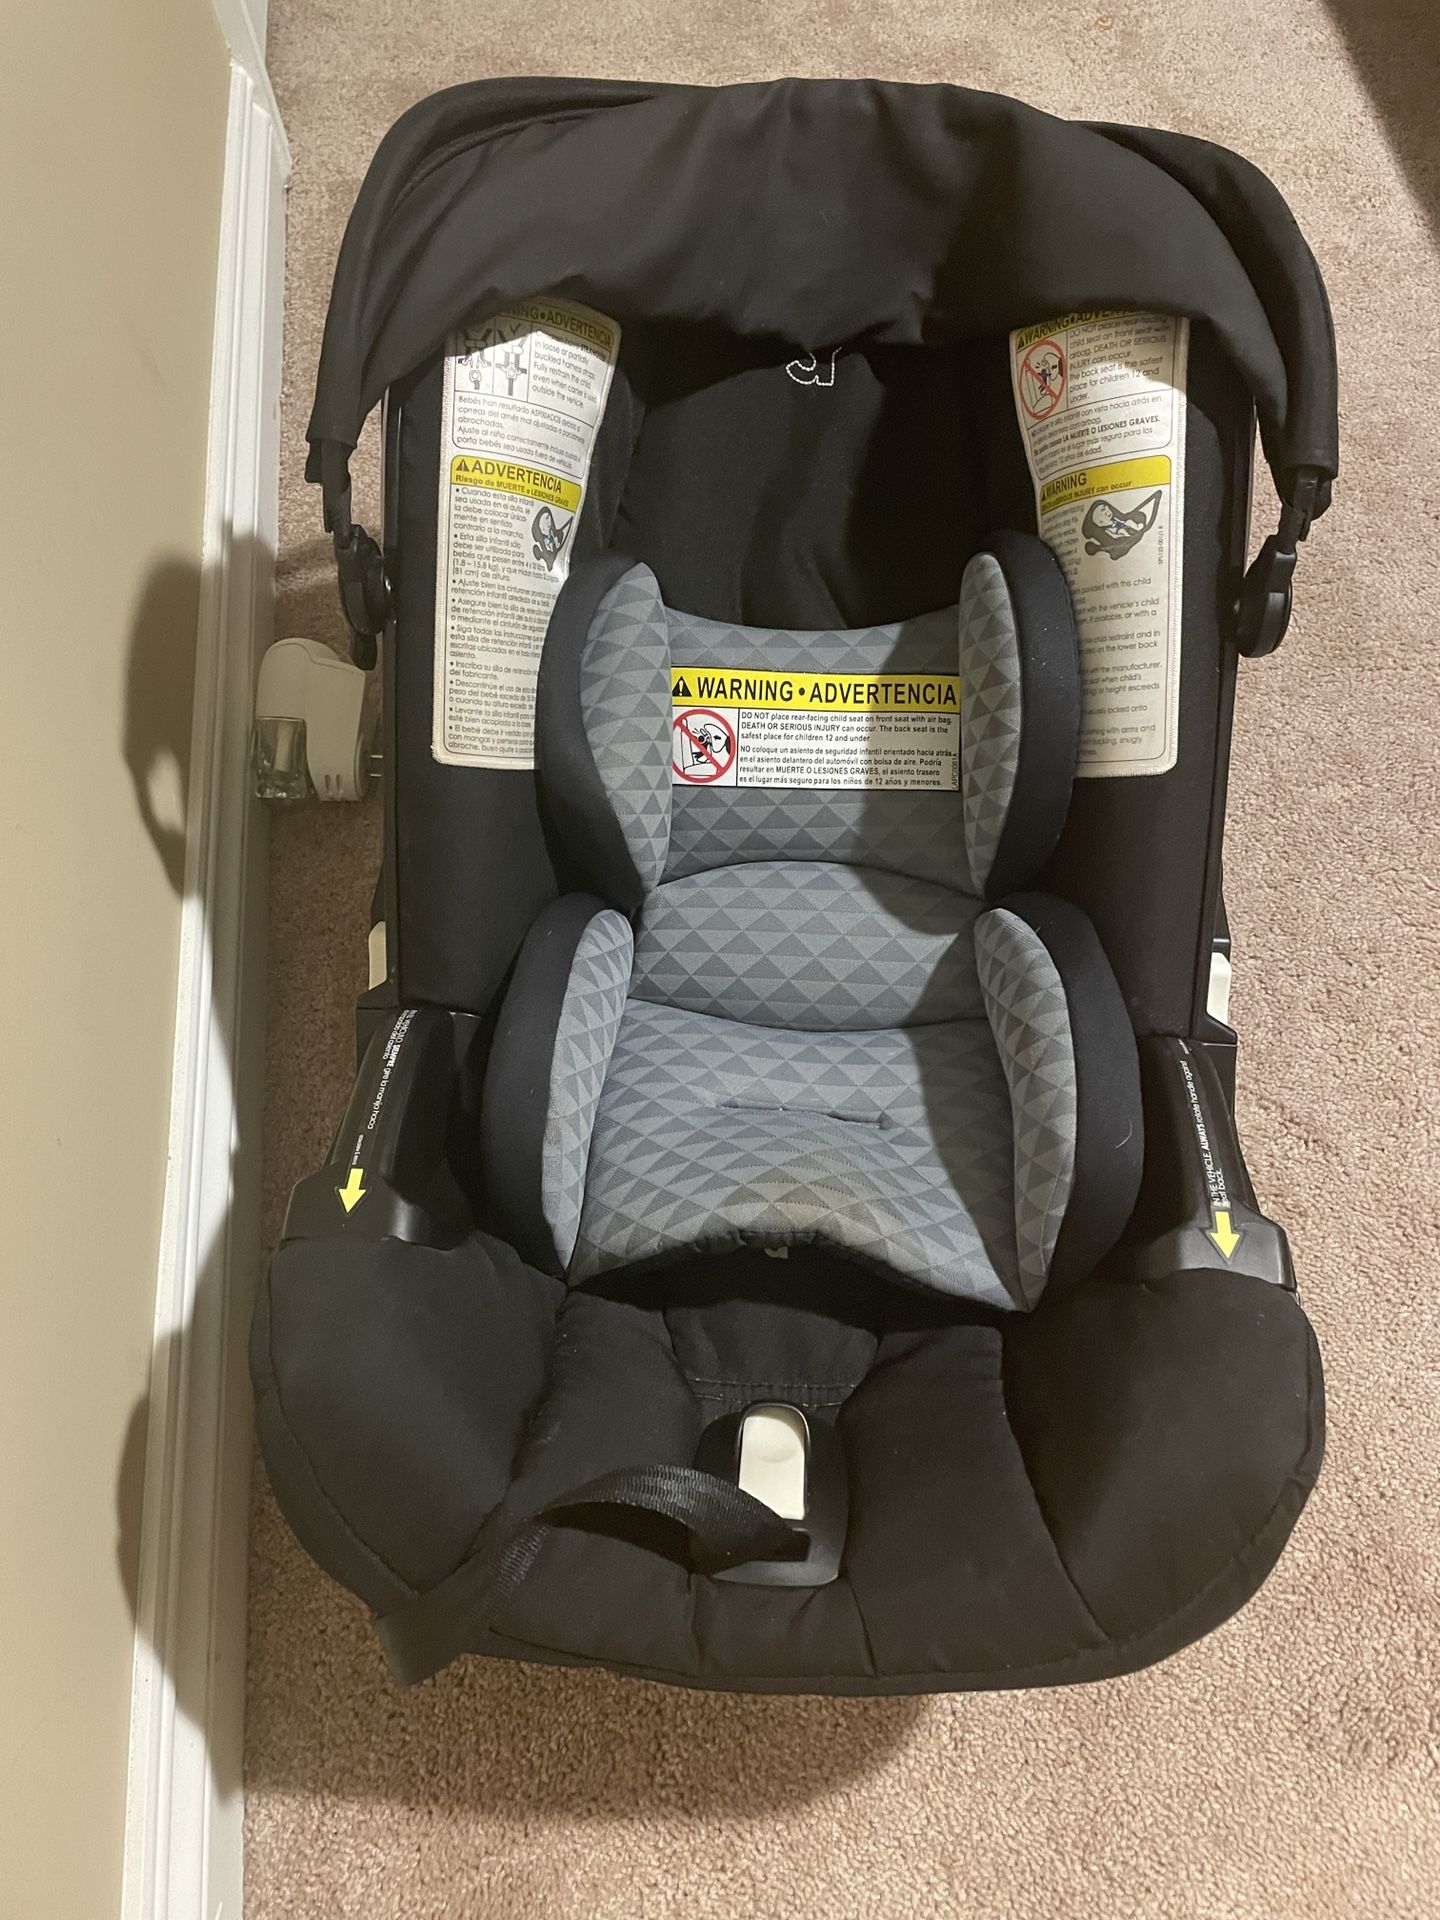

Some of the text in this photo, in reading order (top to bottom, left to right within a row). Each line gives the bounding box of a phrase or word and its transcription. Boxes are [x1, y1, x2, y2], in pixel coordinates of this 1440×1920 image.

[547, 311, 611, 347] ADVERTENCIA
[1094, 341, 1117, 353] DEATH
[1081, 368, 1098, 378] back
[1100, 364, 1115, 373] seat
[1100, 373, 1129, 384] children
[1143, 368, 1159, 376] and
[1110, 401, 1129, 409] hacia
[1098, 420, 1126, 432] LESIONES
[1124, 429, 1141, 438] para
[472, 460, 562, 493] ADVERTENCIA
[497, 481, 525, 493] MUERTE
[1046, 473, 1087, 498] WARNING
[462, 487, 491, 497] Cuando
[463, 505, 482, 514] debe
[1141, 598, 1158, 606] child
[1136, 630, 1151, 638] and
[1138, 640, 1158, 649] back
[697, 677, 956, 705] WARNING ADVERTENCIA
[1128, 682, 1159, 691] exceeds
[792, 714, 828, 723] rear-facing
[825, 748, 857, 756] seguridad
[1196, 1124, 1209, 1150] ALWAYS
